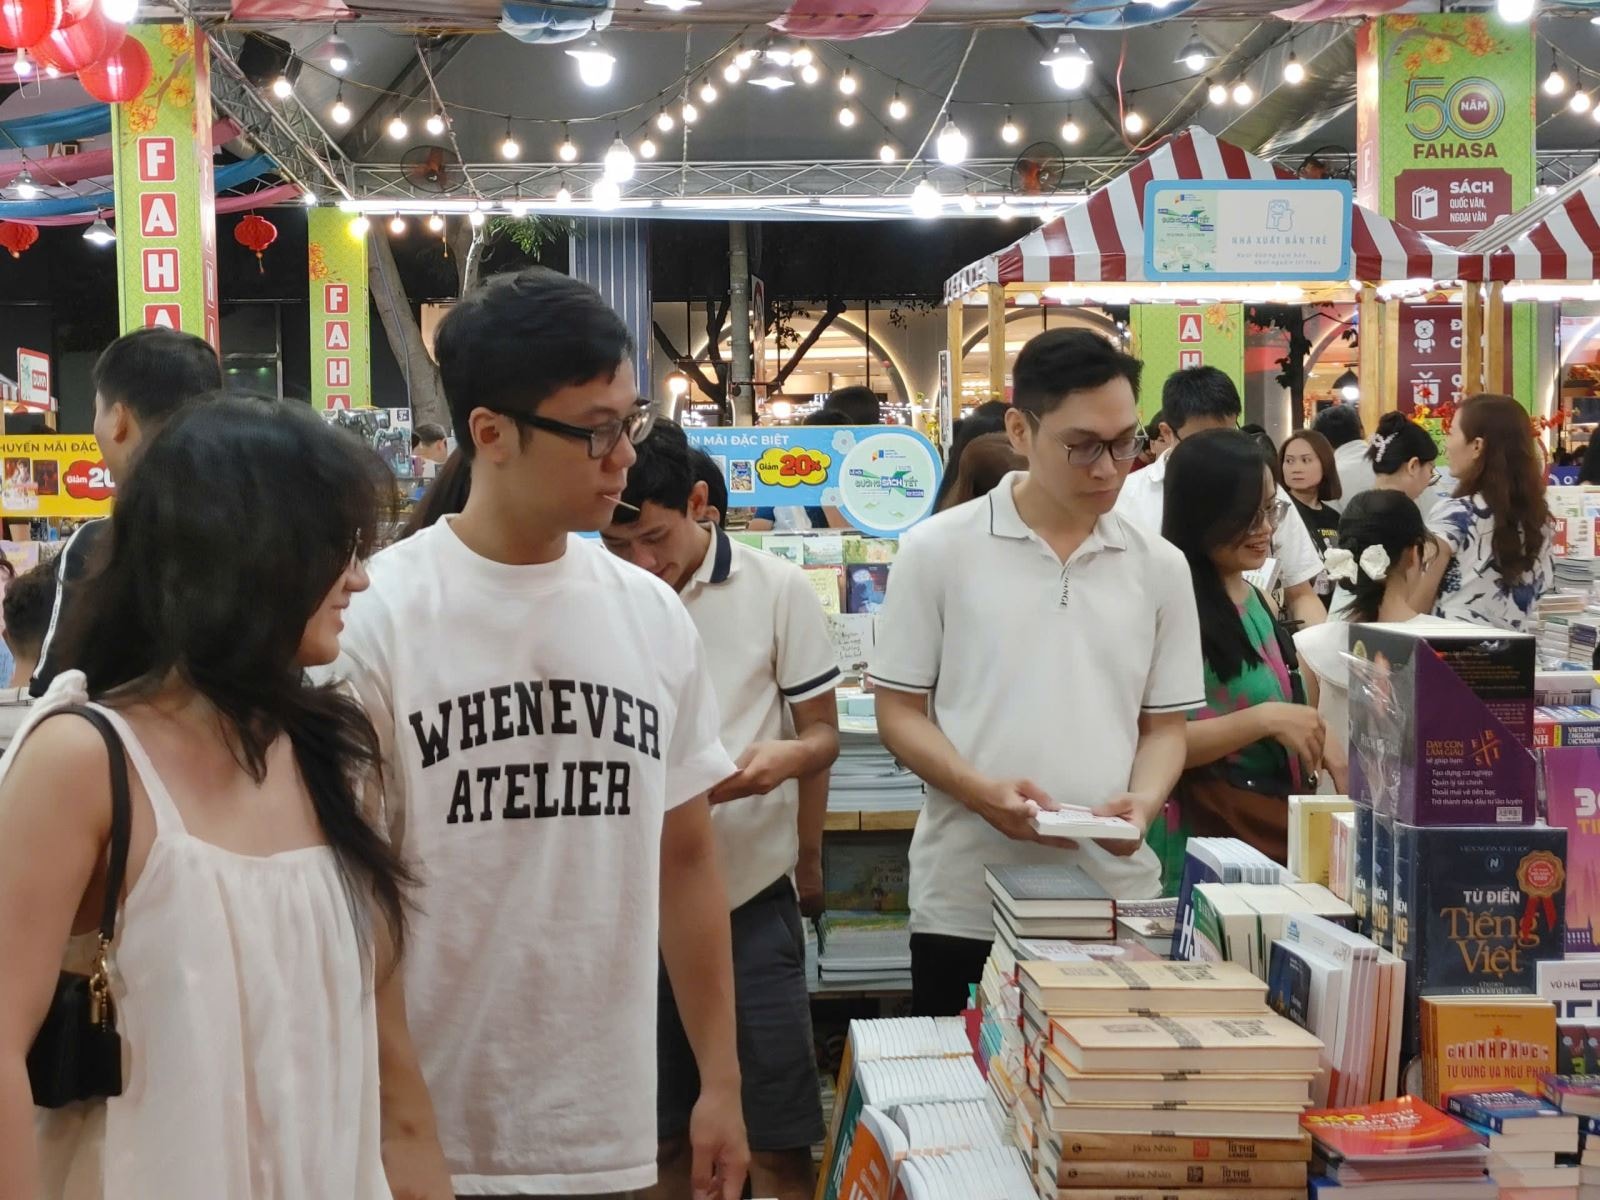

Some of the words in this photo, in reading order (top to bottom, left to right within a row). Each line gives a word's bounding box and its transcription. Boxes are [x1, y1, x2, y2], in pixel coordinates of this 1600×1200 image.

[1405, 77, 1505, 141] 50
[1461, 99, 1487, 111] NĂM
[1413, 142, 1498, 159] FAHASA
[1450, 178, 1494, 194] SÁCH
[1450, 195, 1468, 209] QUỐC
[1450, 212, 1471, 223] NGOẠI
[1472, 211, 1487, 222] VĂN
[44, 441, 67, 452] MÃI
[71, 441, 97, 454] ĐẶC
[704, 433, 728, 446] MÃI
[731, 434, 758, 448] ĐẶC
[761, 434, 789, 448] BIỆT
[759, 462, 779, 471] Giảm
[780, 454, 822, 477] 20%
[408, 679, 661, 769] WHENEVER
[446, 760, 631, 824] ATELIER
[1486, 886, 1520, 905] ĐIỂN
[1440, 907, 1541, 948] Tiếng
[1455, 940, 1524, 979] Việt
